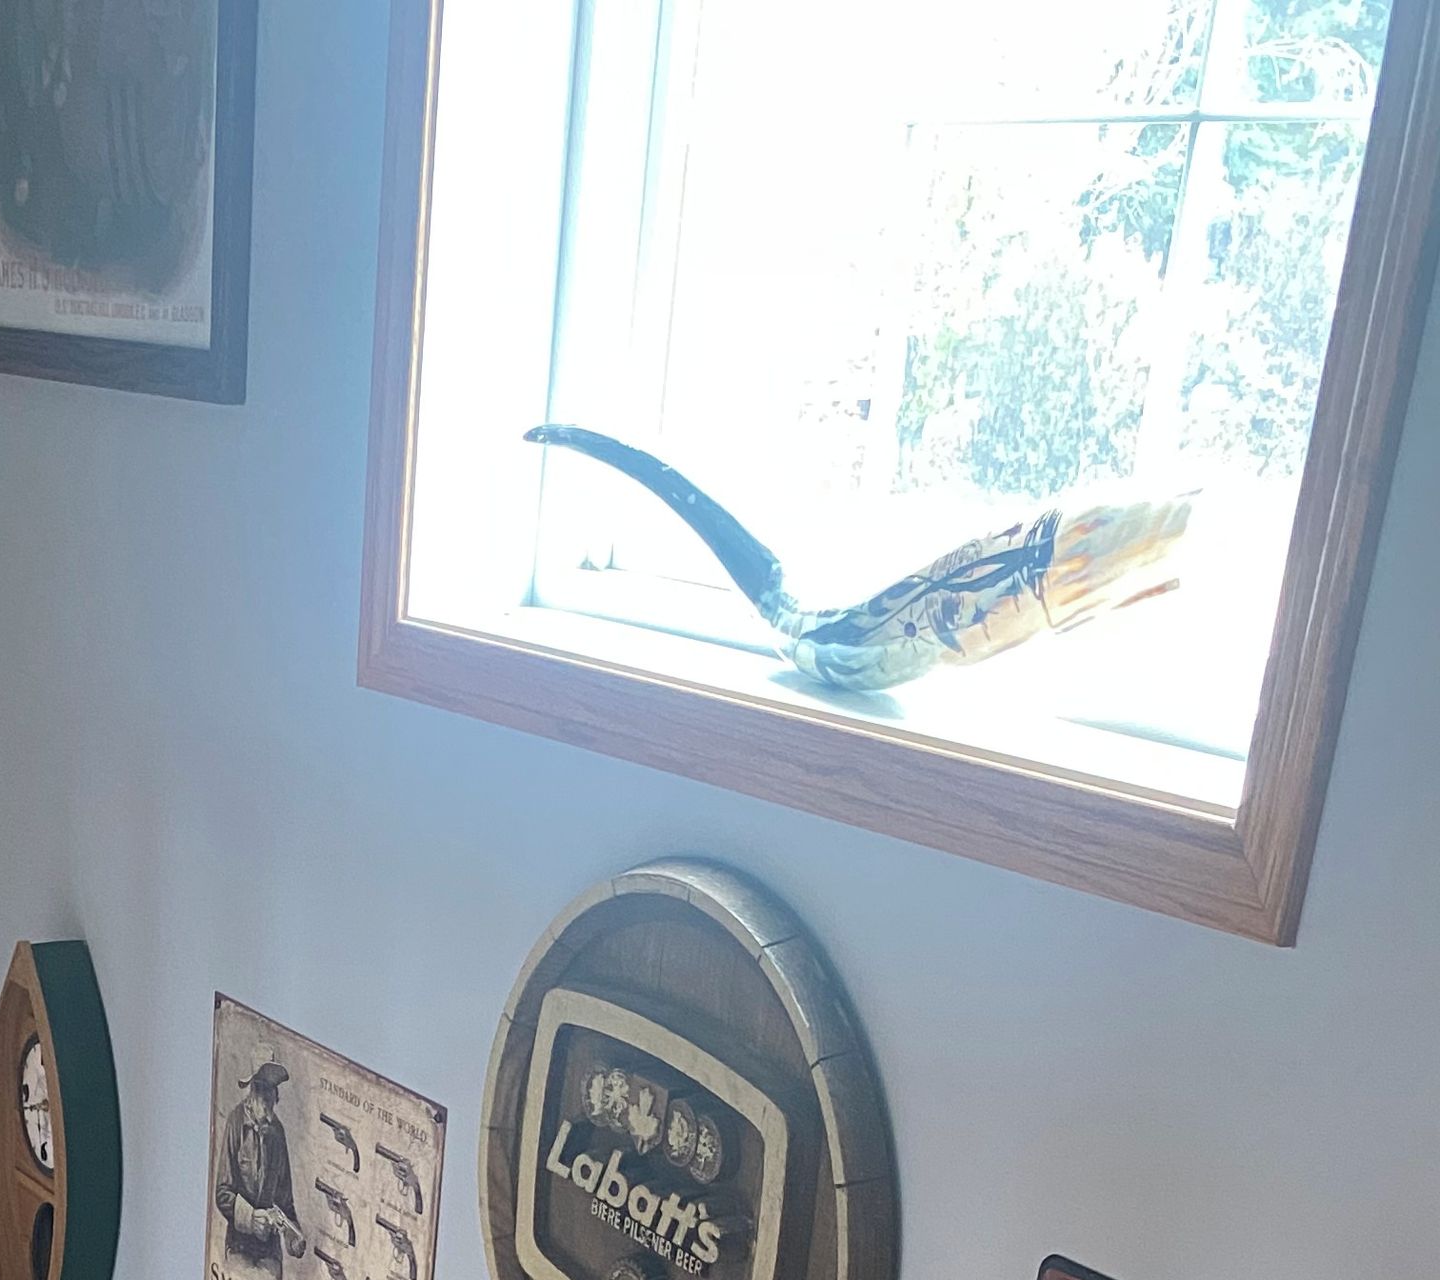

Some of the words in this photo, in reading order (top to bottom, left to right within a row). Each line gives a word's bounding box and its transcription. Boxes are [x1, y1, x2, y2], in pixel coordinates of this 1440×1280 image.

[546, 1120, 720, 1263] Labatt's
[591, 1198, 621, 1230] BIERE
[623, 1215, 672, 1260] PILSENER
[675, 1246, 703, 1277] BEER
